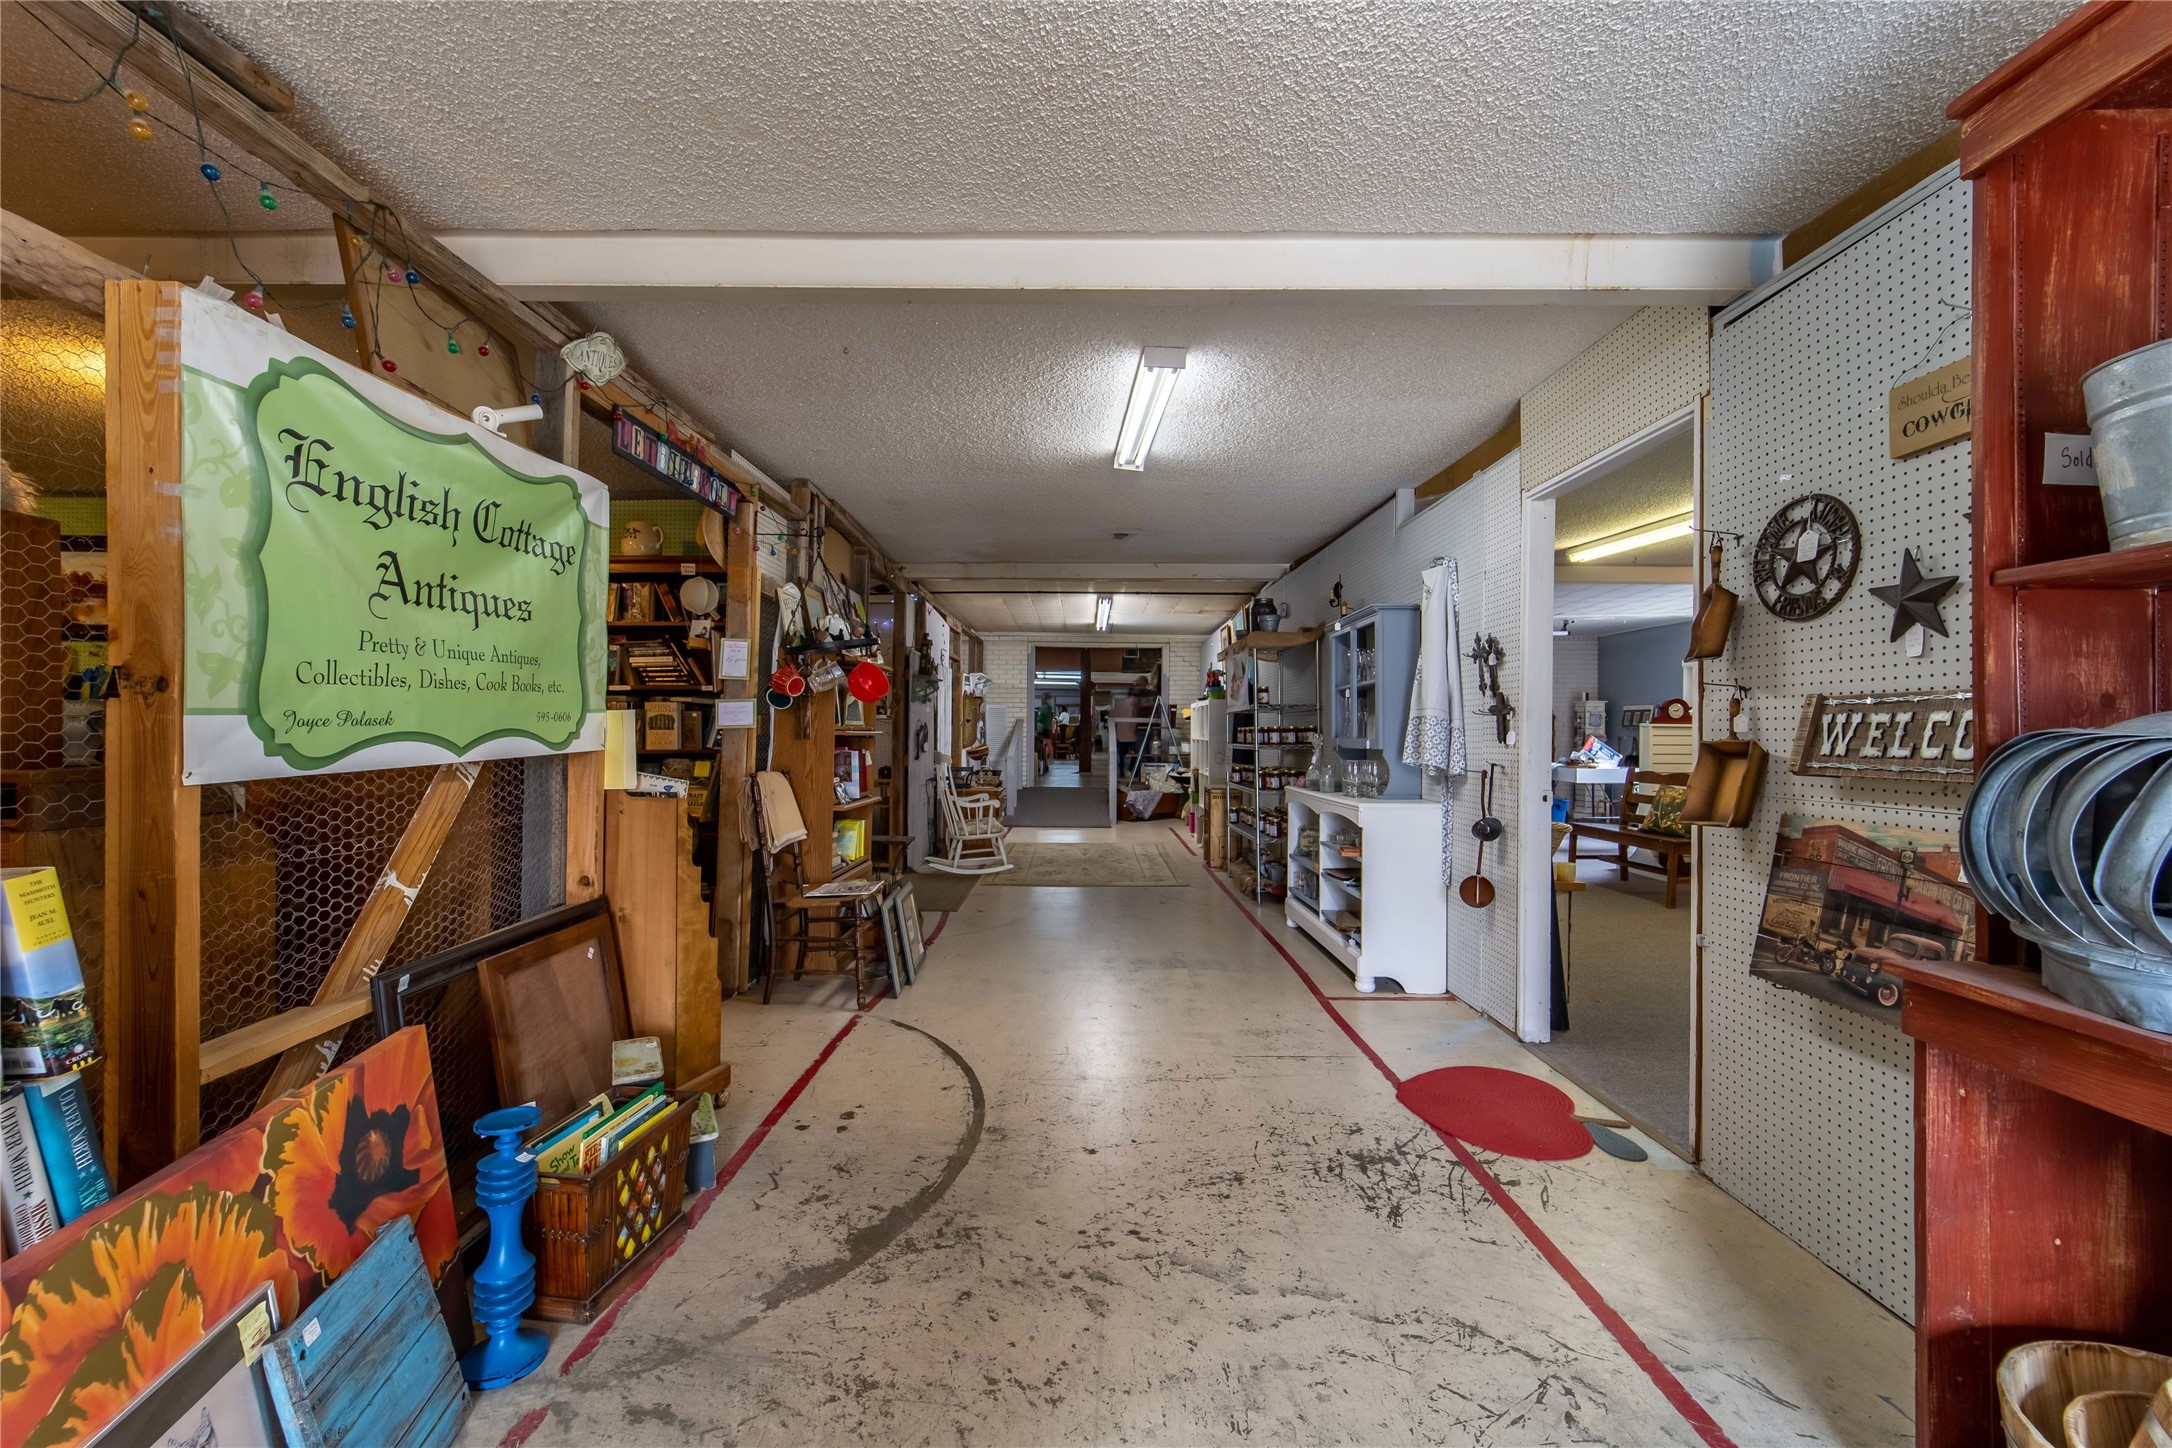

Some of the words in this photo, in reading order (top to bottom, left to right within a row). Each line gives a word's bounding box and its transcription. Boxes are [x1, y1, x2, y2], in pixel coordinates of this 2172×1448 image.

[578, 349, 617, 373] ANTIQUES
[1897, 382, 1947, 411] Shoulda
[2061, 446, 2093, 469] Sold
[277, 428, 462, 547] English
[473, 498, 576, 576] Cottage
[368, 550, 533, 632] Antiques
[358, 630, 409, 659] Pretty
[415, 637, 427, 657] &
[432, 639, 486, 666] Unique
[490, 645, 541, 669] Antiques,
[296, 659, 412, 692] Collectibles,
[419, 668, 471, 693] Dishes,
[475, 671, 508, 692] Cook
[511, 675, 545, 695] Books,
[548, 682, 565, 693] etc.
[283, 709, 333, 734] Joyce
[336, 710, 395, 729] Polasek
[536, 711, 572, 722] 595-0606
[1819, 710, 1974, 761] WELCO
[19, 884, 57, 898] MAMMOTH
[29, 879, 43, 887] THE
[1779, 871, 1818, 884] FRONTIER
[24, 892, 56, 906] HUNTERS
[30, 911, 48, 922] JEAN
[37, 917, 55, 927] AUEL
[66, 1048, 95, 1065] CROWN
[0, 1105, 23, 1152] OLIVER
[58, 1088, 78, 1131] OLIVER
[69, 1124, 94, 1170] NORTH
[8, 1144, 34, 1192] NORTH
[550, 1144, 575, 1174] Show
[14, 1203, 38, 1251] COMPROMI
[30, 1199, 55, 1243] MISSIO
